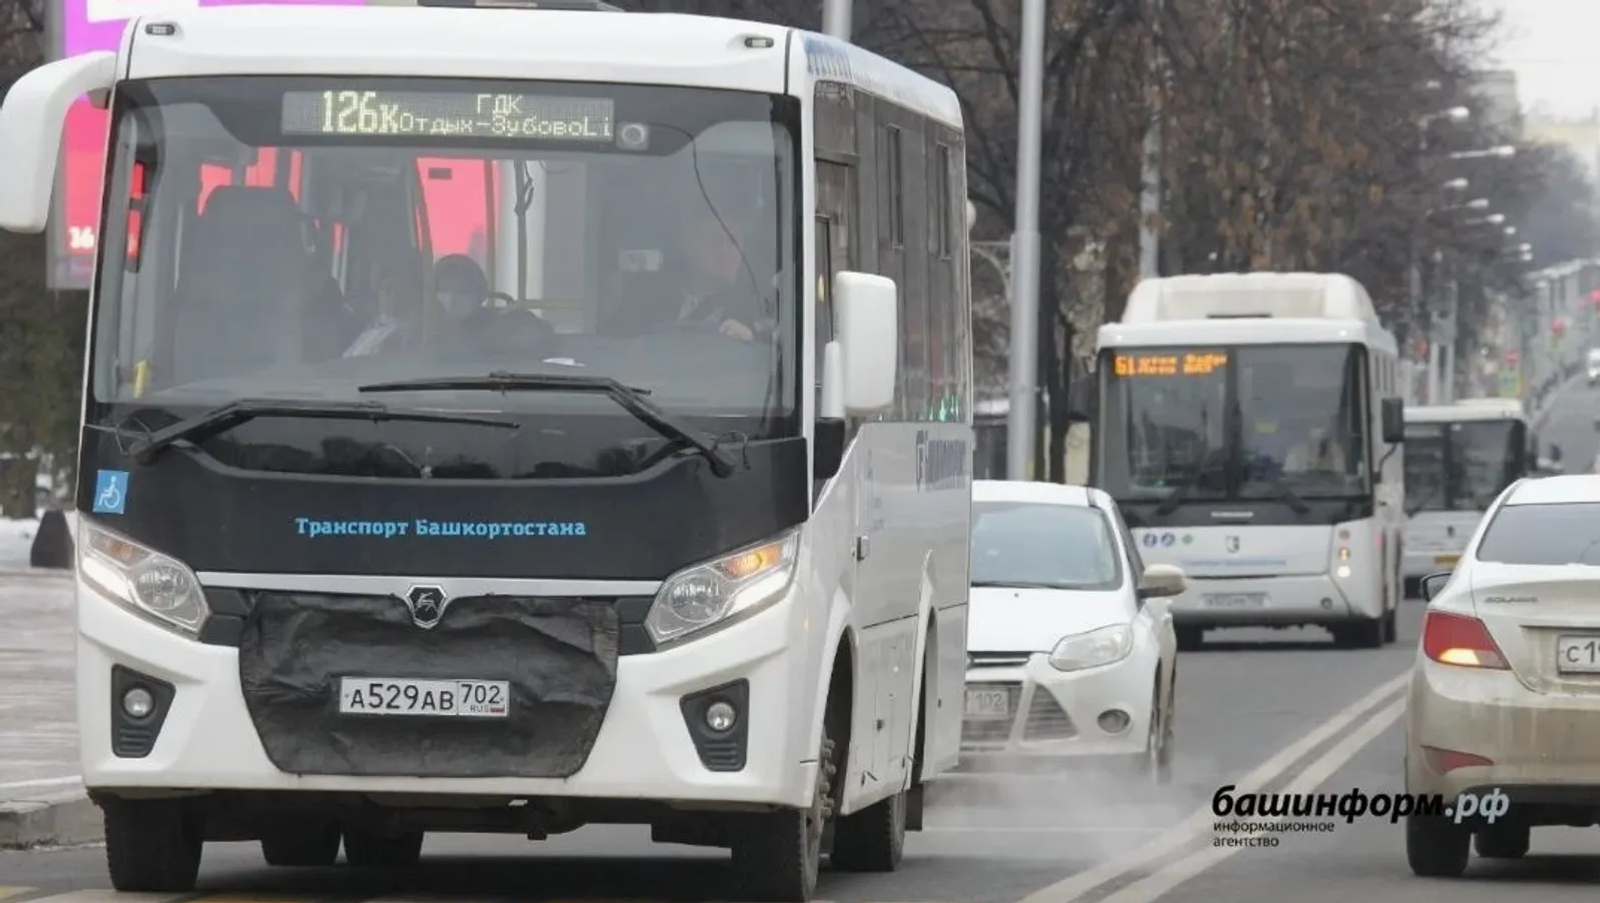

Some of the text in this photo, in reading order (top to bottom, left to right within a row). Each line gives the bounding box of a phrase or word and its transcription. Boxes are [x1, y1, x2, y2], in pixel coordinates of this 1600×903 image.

[477, 93, 523, 116] ГДК
[295, 517, 587, 540] Транспорт Башкортостана
[350, 683, 501, 711] А529АВ 702
